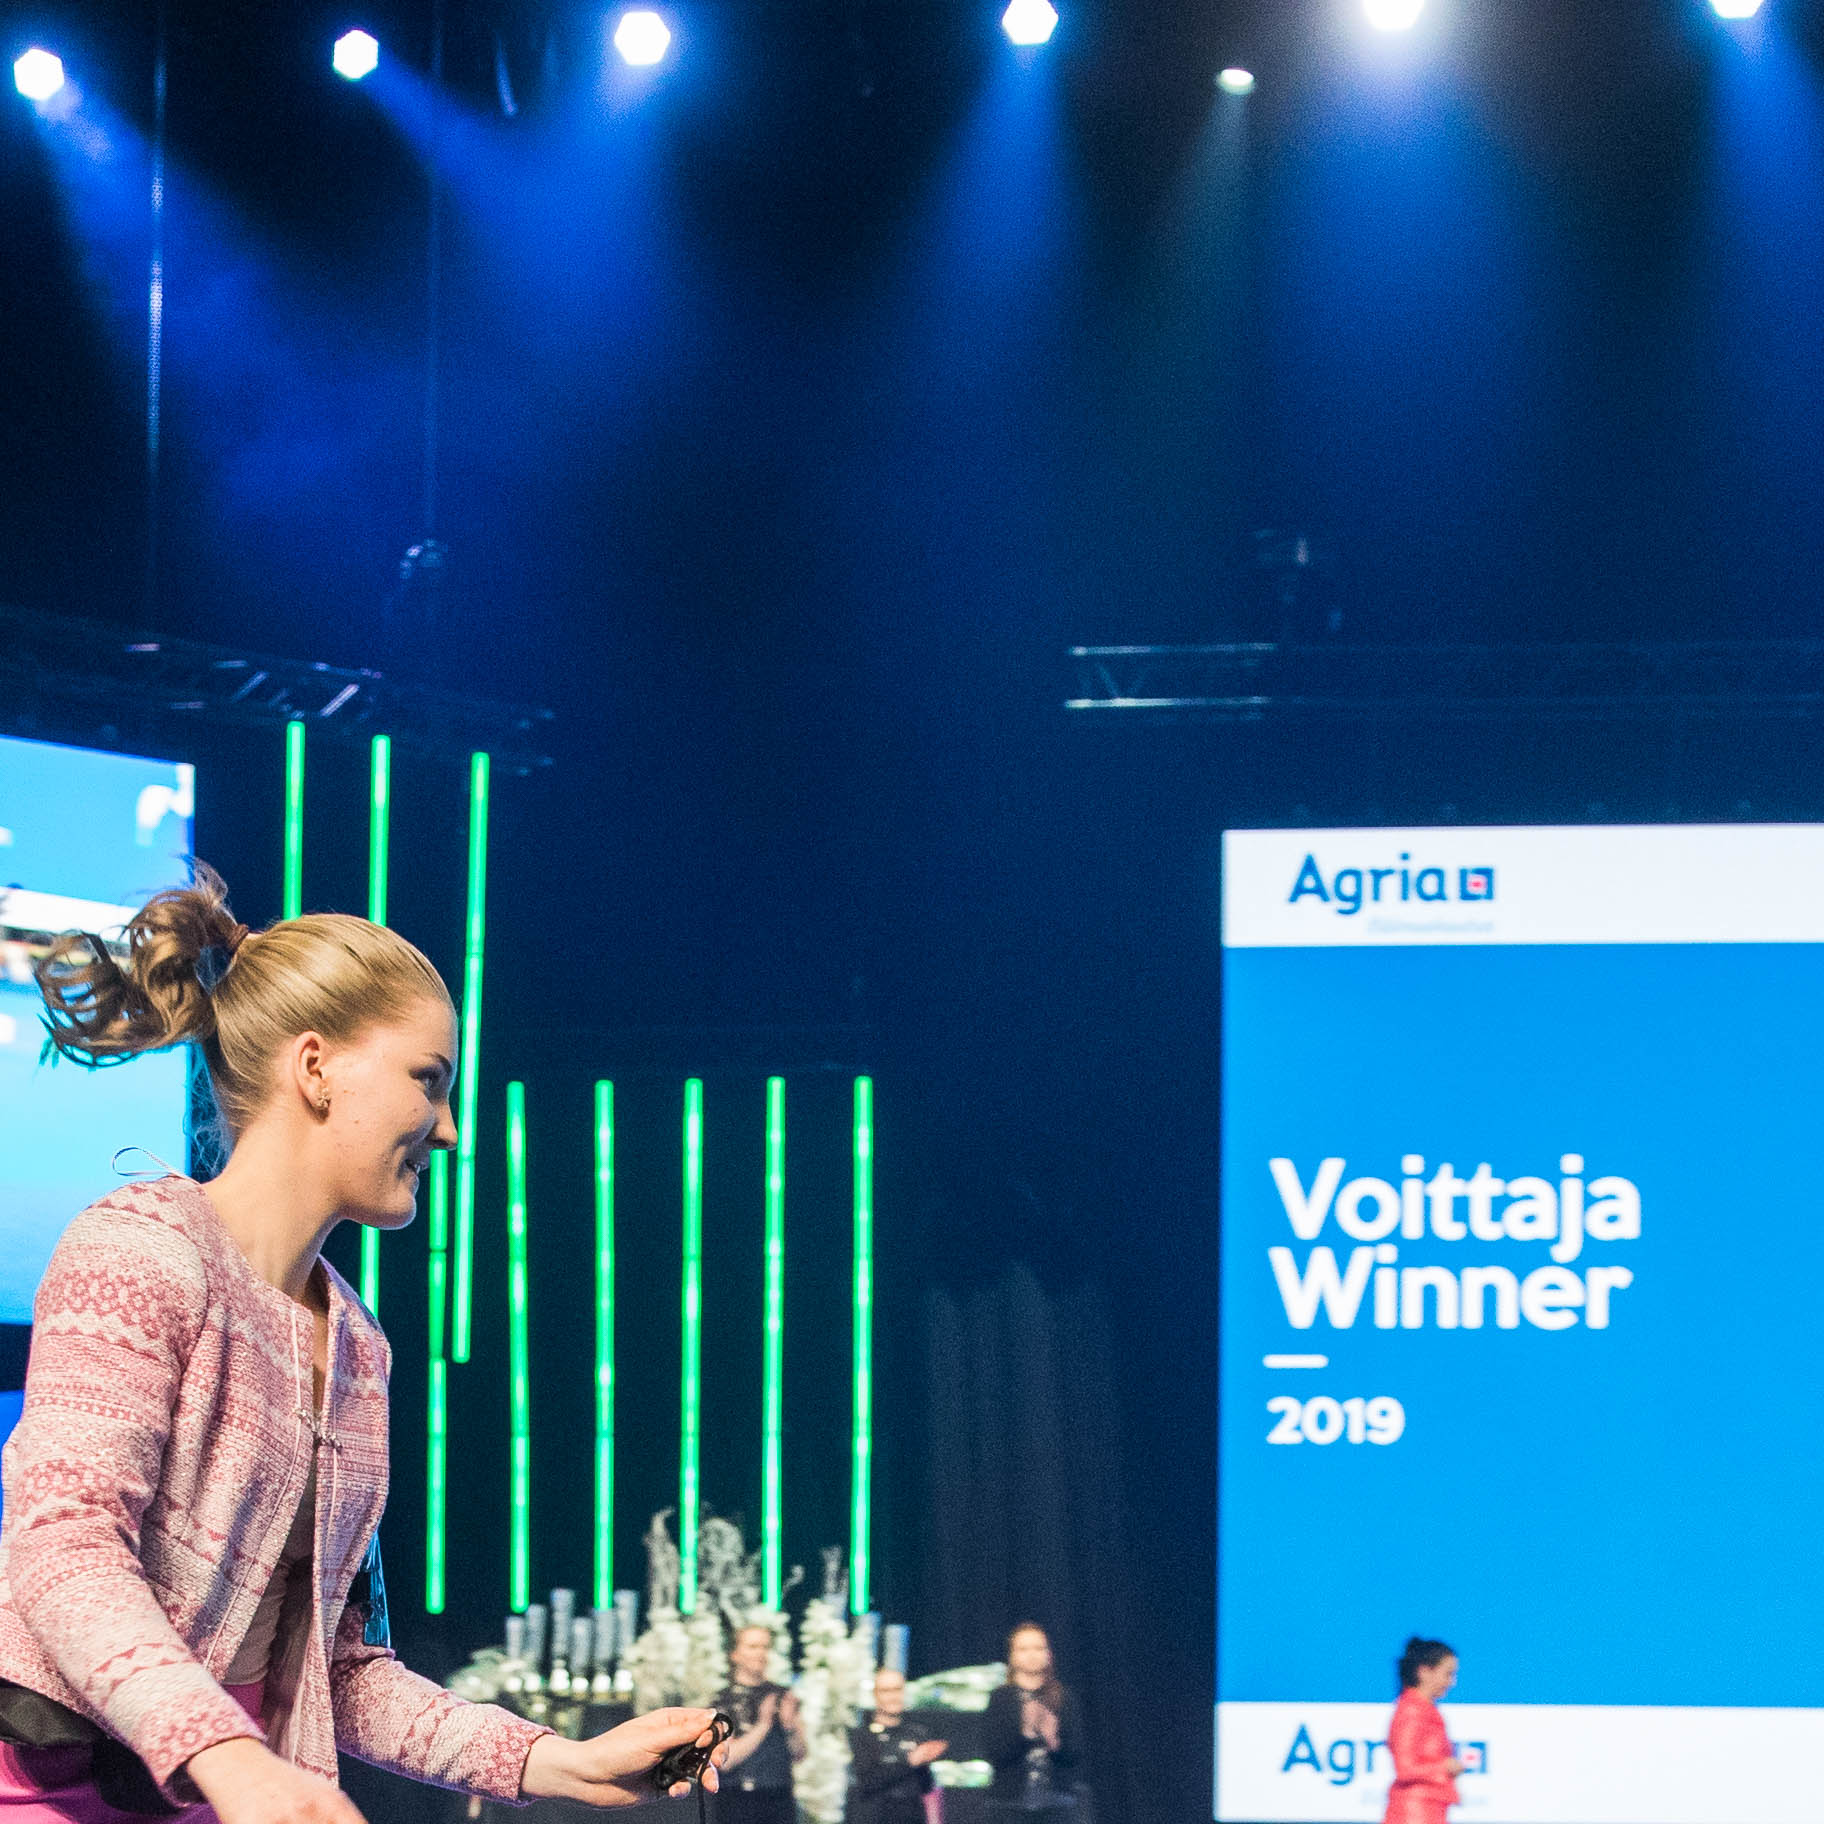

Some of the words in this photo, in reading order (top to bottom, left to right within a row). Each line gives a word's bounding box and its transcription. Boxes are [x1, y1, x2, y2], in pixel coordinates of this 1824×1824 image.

[1287, 851, 1447, 915] Agria
[1268, 1152, 1643, 1263] Voittaja
[1267, 1246, 1635, 1332] Winner
[1266, 1395, 1406, 1446] 2019
[1281, 1722, 1389, 1786] Agr
